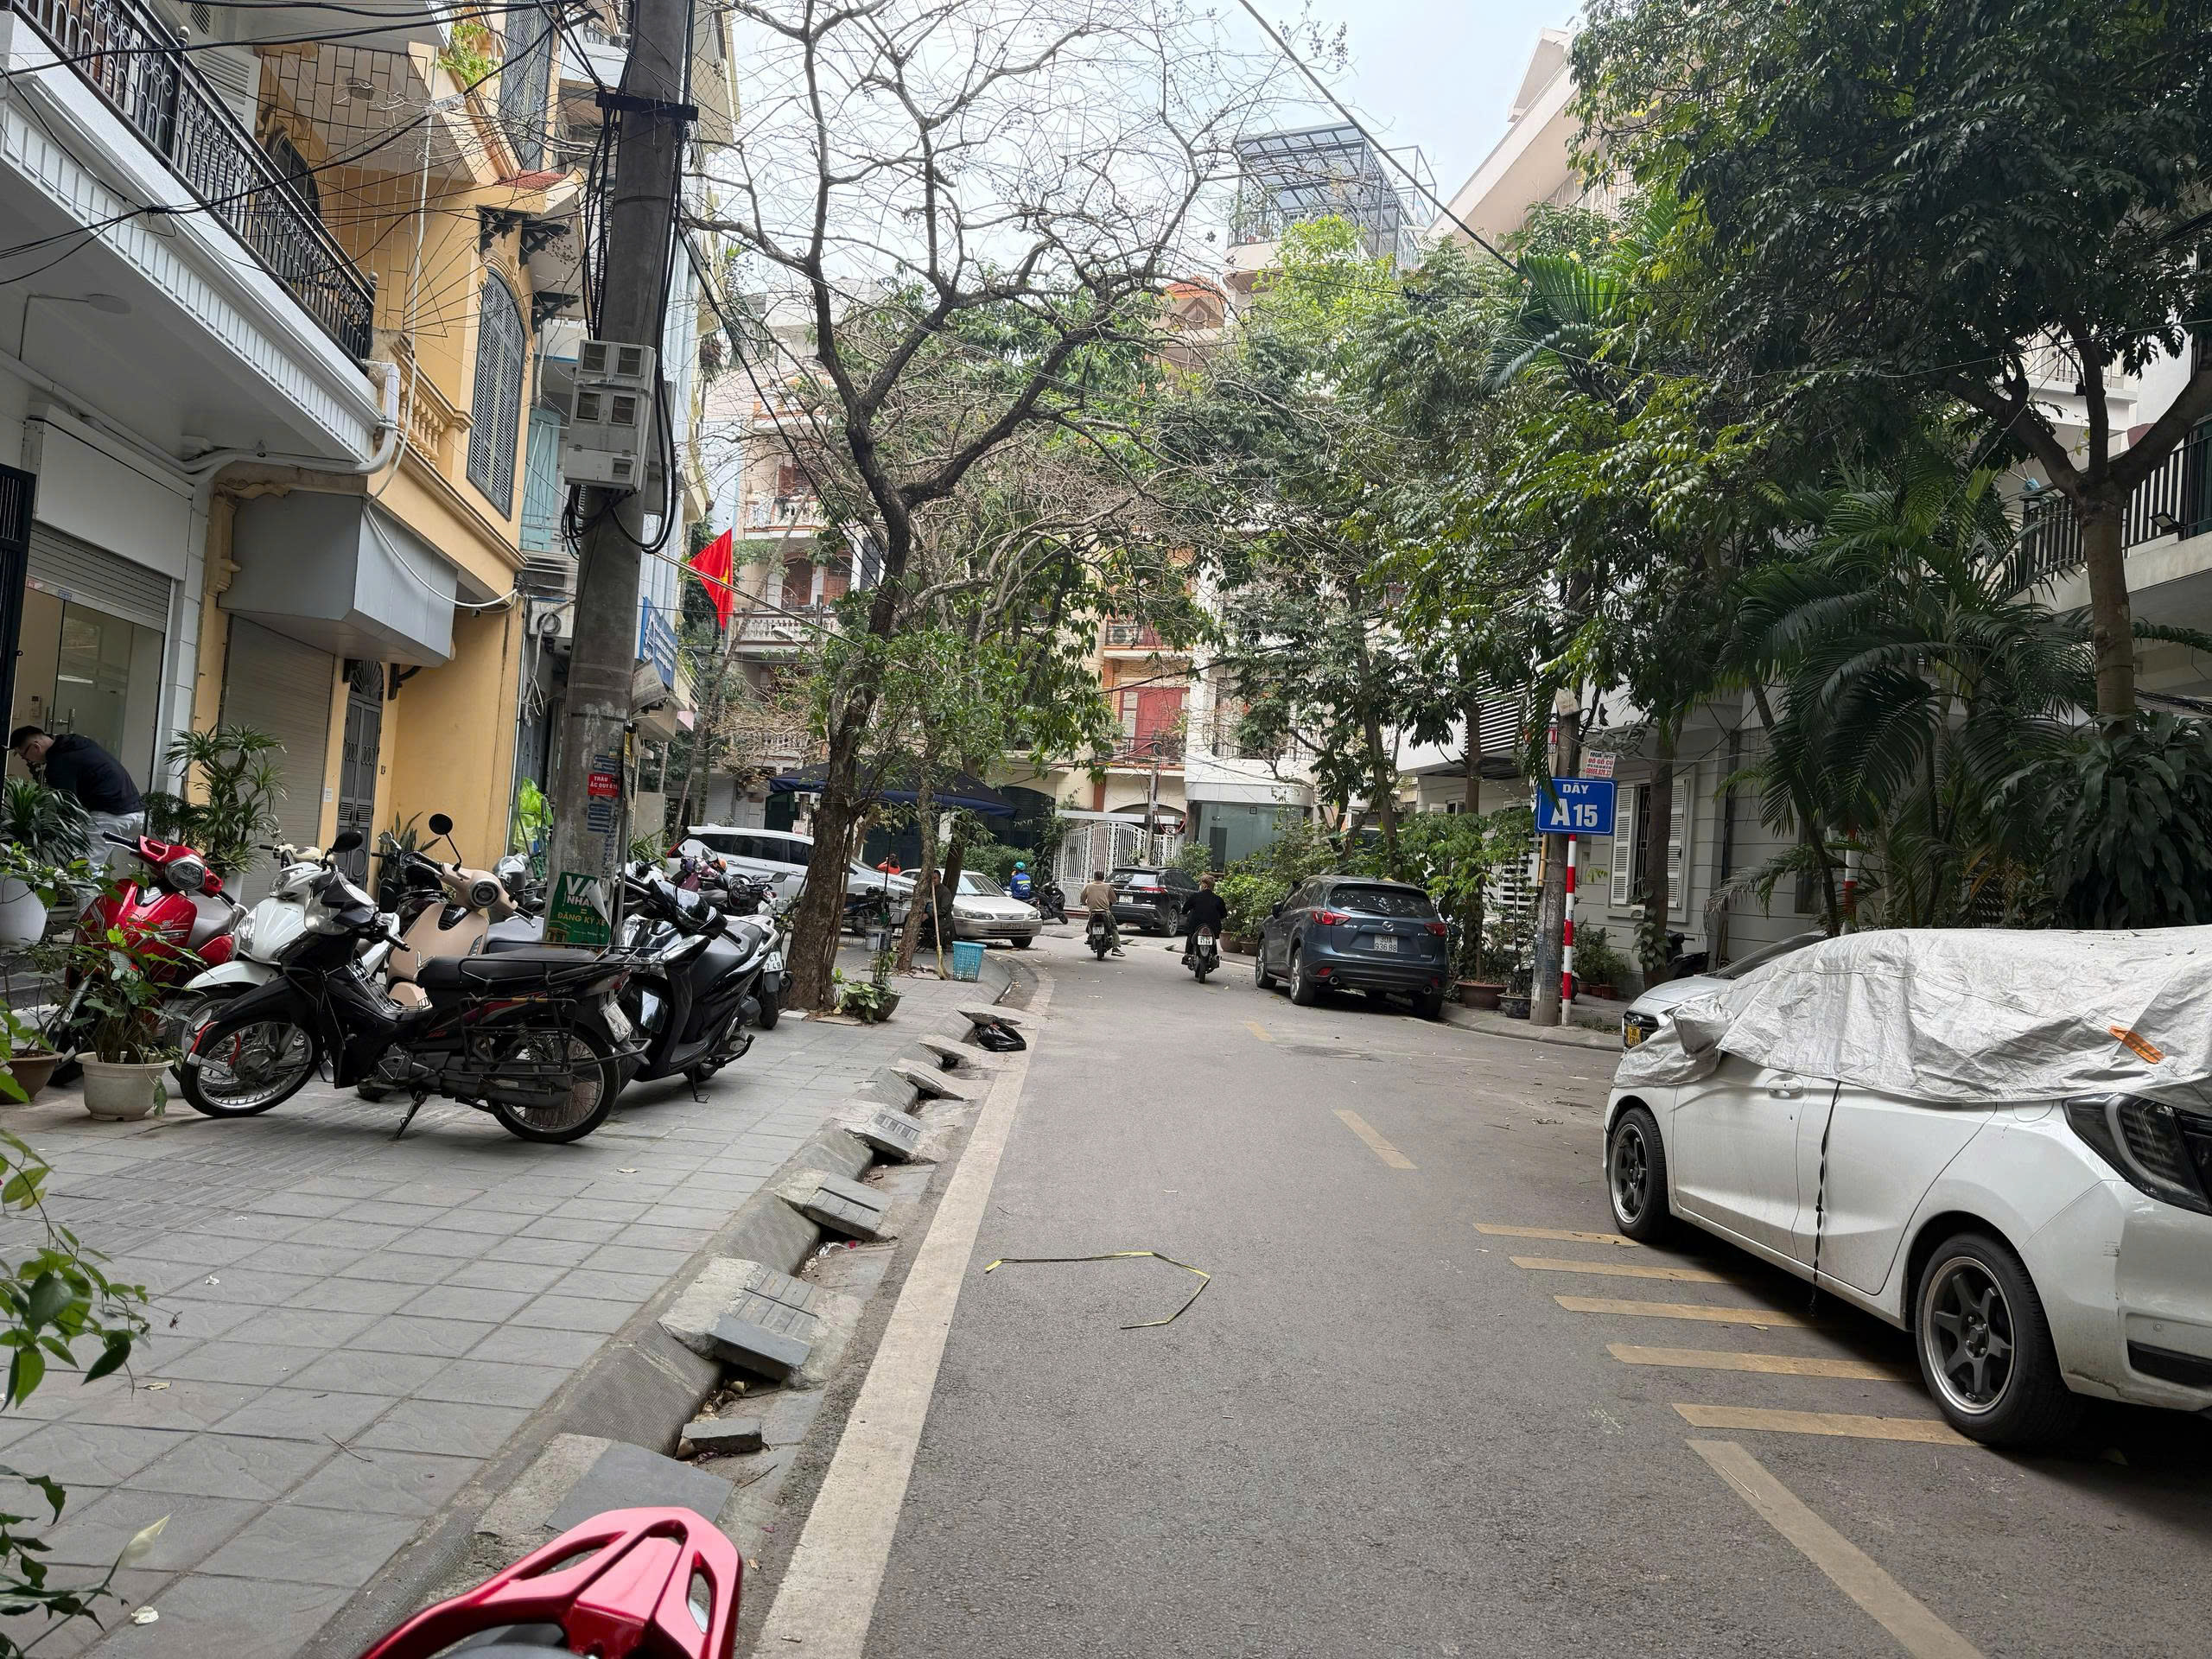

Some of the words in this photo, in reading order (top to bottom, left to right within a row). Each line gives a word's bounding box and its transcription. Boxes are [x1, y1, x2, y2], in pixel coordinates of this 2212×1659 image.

[1562, 782, 1589, 794] DÃY
[1550, 798, 1598, 828] A15
[566, 875, 595, 897] VA
